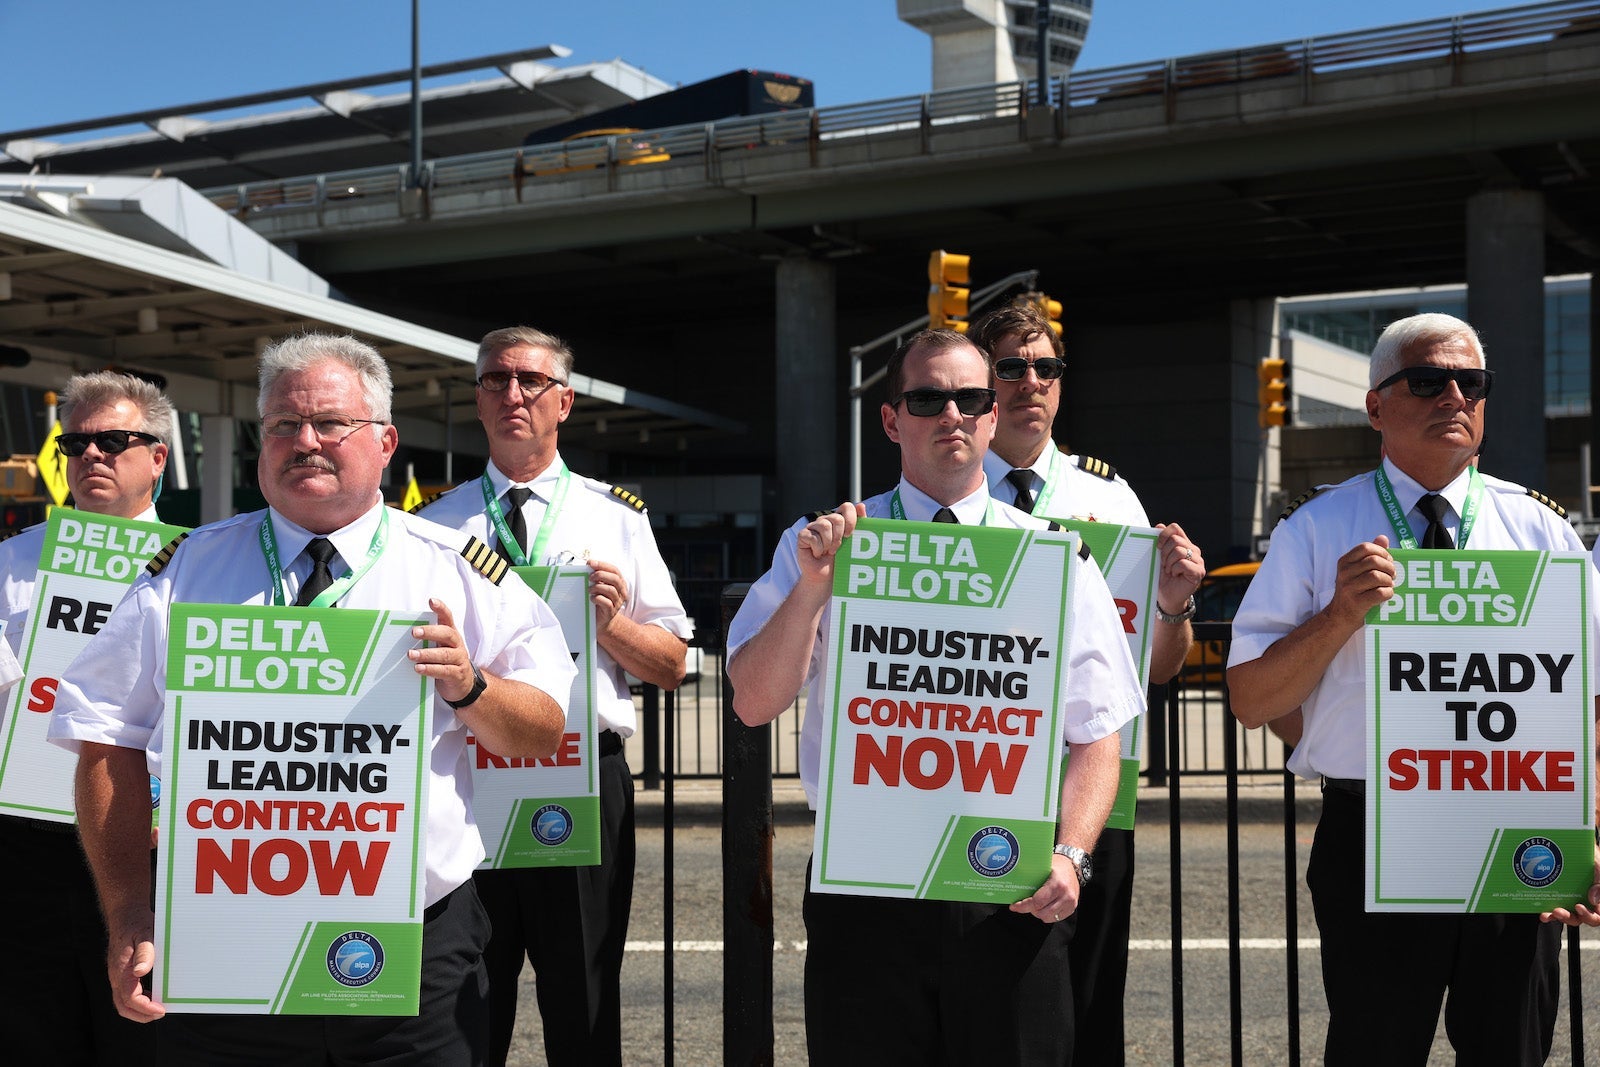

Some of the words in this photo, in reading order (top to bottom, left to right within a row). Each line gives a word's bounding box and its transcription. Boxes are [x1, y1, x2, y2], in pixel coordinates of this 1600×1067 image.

[1387, 502, 1400, 520] NEW
[1461, 516, 1473, 540] MORE
[57, 518, 161, 556] DELTA
[850, 529, 978, 568] DELTA
[1399, 528, 1409, 540] TO
[51, 545, 149, 580] PILOT
[269, 552, 277, 569] NOT
[848, 565, 994, 604] PILOTS
[1380, 593, 1517, 623] PILOTS
[186, 617, 329, 653] DELTA
[850, 624, 1050, 665] INDUSTRY-
[183, 655, 346, 691] PILOTS
[866, 661, 1028, 700] LEADING
[1389, 651, 1575, 693] READY
[847, 696, 1043, 737] CONTRACT
[1445, 701, 1517, 742] TO
[187, 719, 410, 755] INDUSTRY-
[207, 759, 388, 794] LEADING
[853, 733, 1029, 795] NOW
[1388, 748, 1575, 791] STRIKE
[186, 798, 405, 833] CONTRACT
[981, 828, 1008, 837] DELTA
[1525, 839, 1551, 848] DELTA
[195, 837, 391, 897] NOW
[1537, 864, 1551, 872] alpa
[342, 933, 371, 942] DELTA
[329, 959, 341, 979] MASTER
[354, 961, 370, 970] alpa
